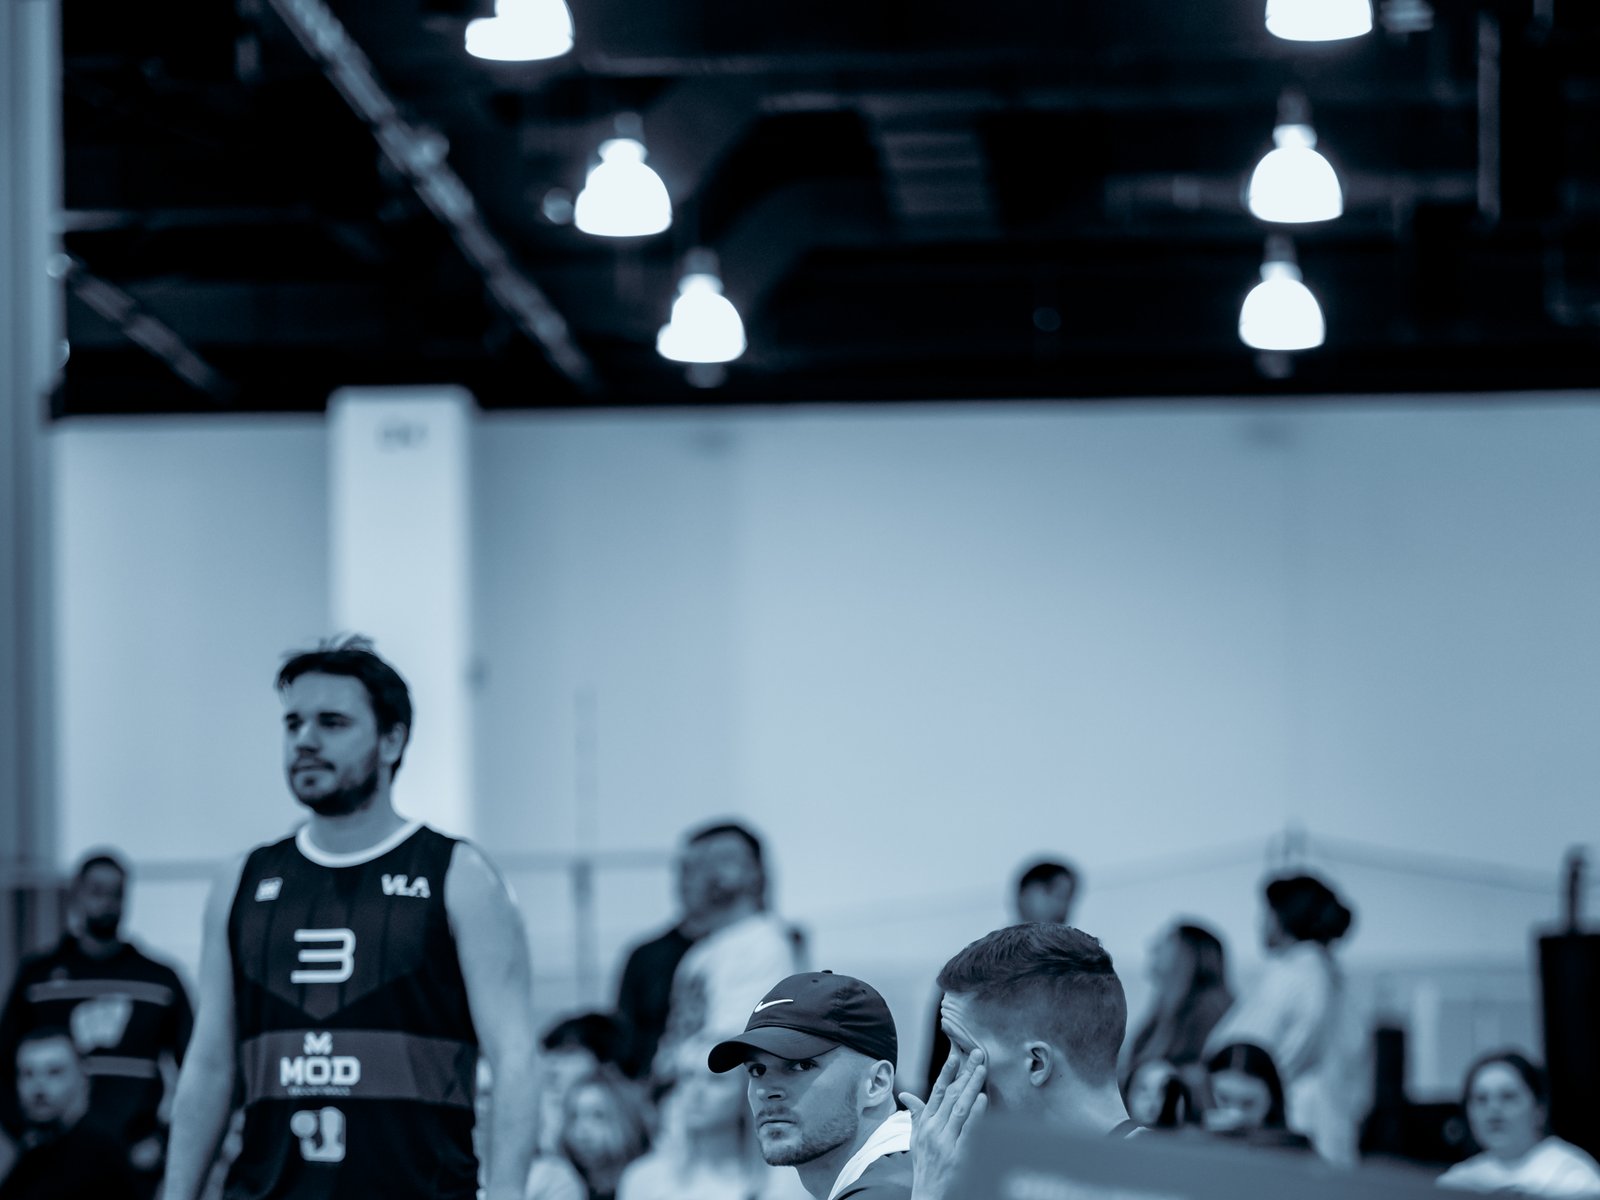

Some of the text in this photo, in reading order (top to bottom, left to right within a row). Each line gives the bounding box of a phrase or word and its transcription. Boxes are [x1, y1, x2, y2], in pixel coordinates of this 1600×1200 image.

[381, 873, 431, 899] VLA
[290, 928, 356, 984] 3
[280, 1055, 361, 1087] MOD
